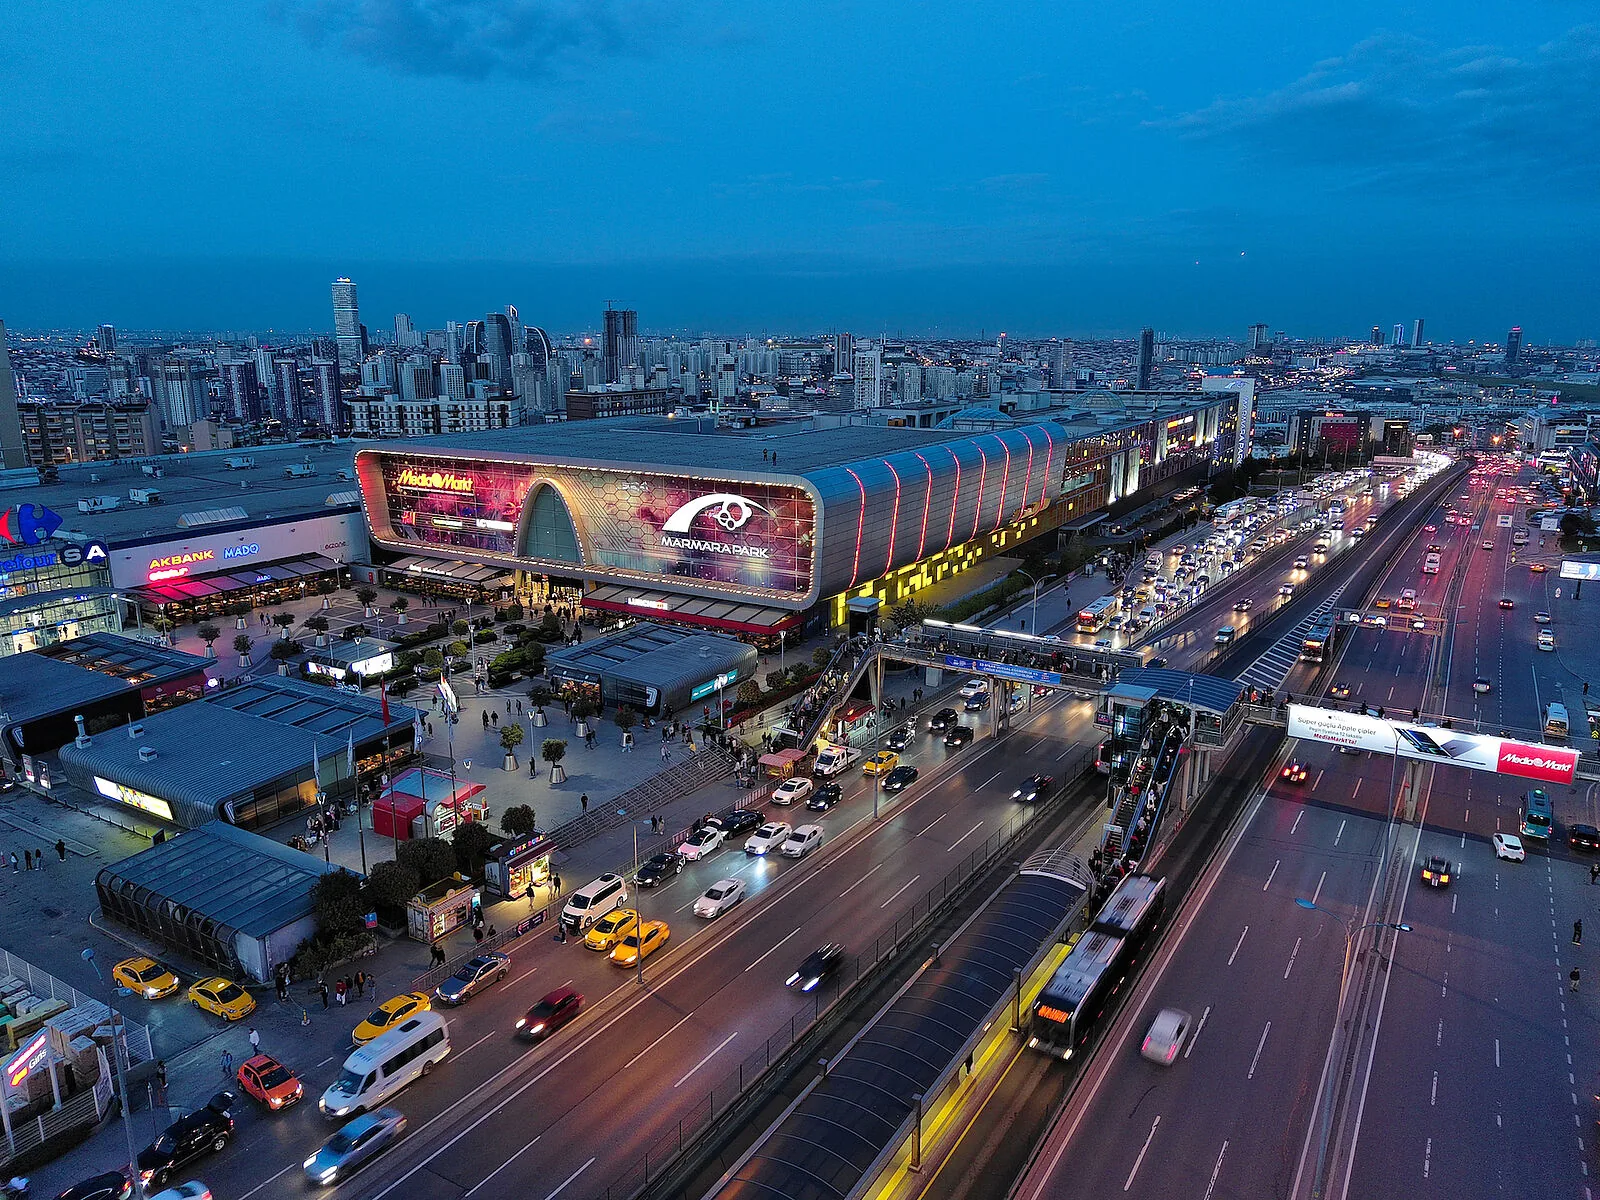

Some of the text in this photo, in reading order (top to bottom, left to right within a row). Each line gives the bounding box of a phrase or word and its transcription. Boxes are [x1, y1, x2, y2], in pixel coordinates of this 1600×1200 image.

[149, 543, 260, 569] AKBANK MADO
[1337, 723, 1357, 733] Apple
